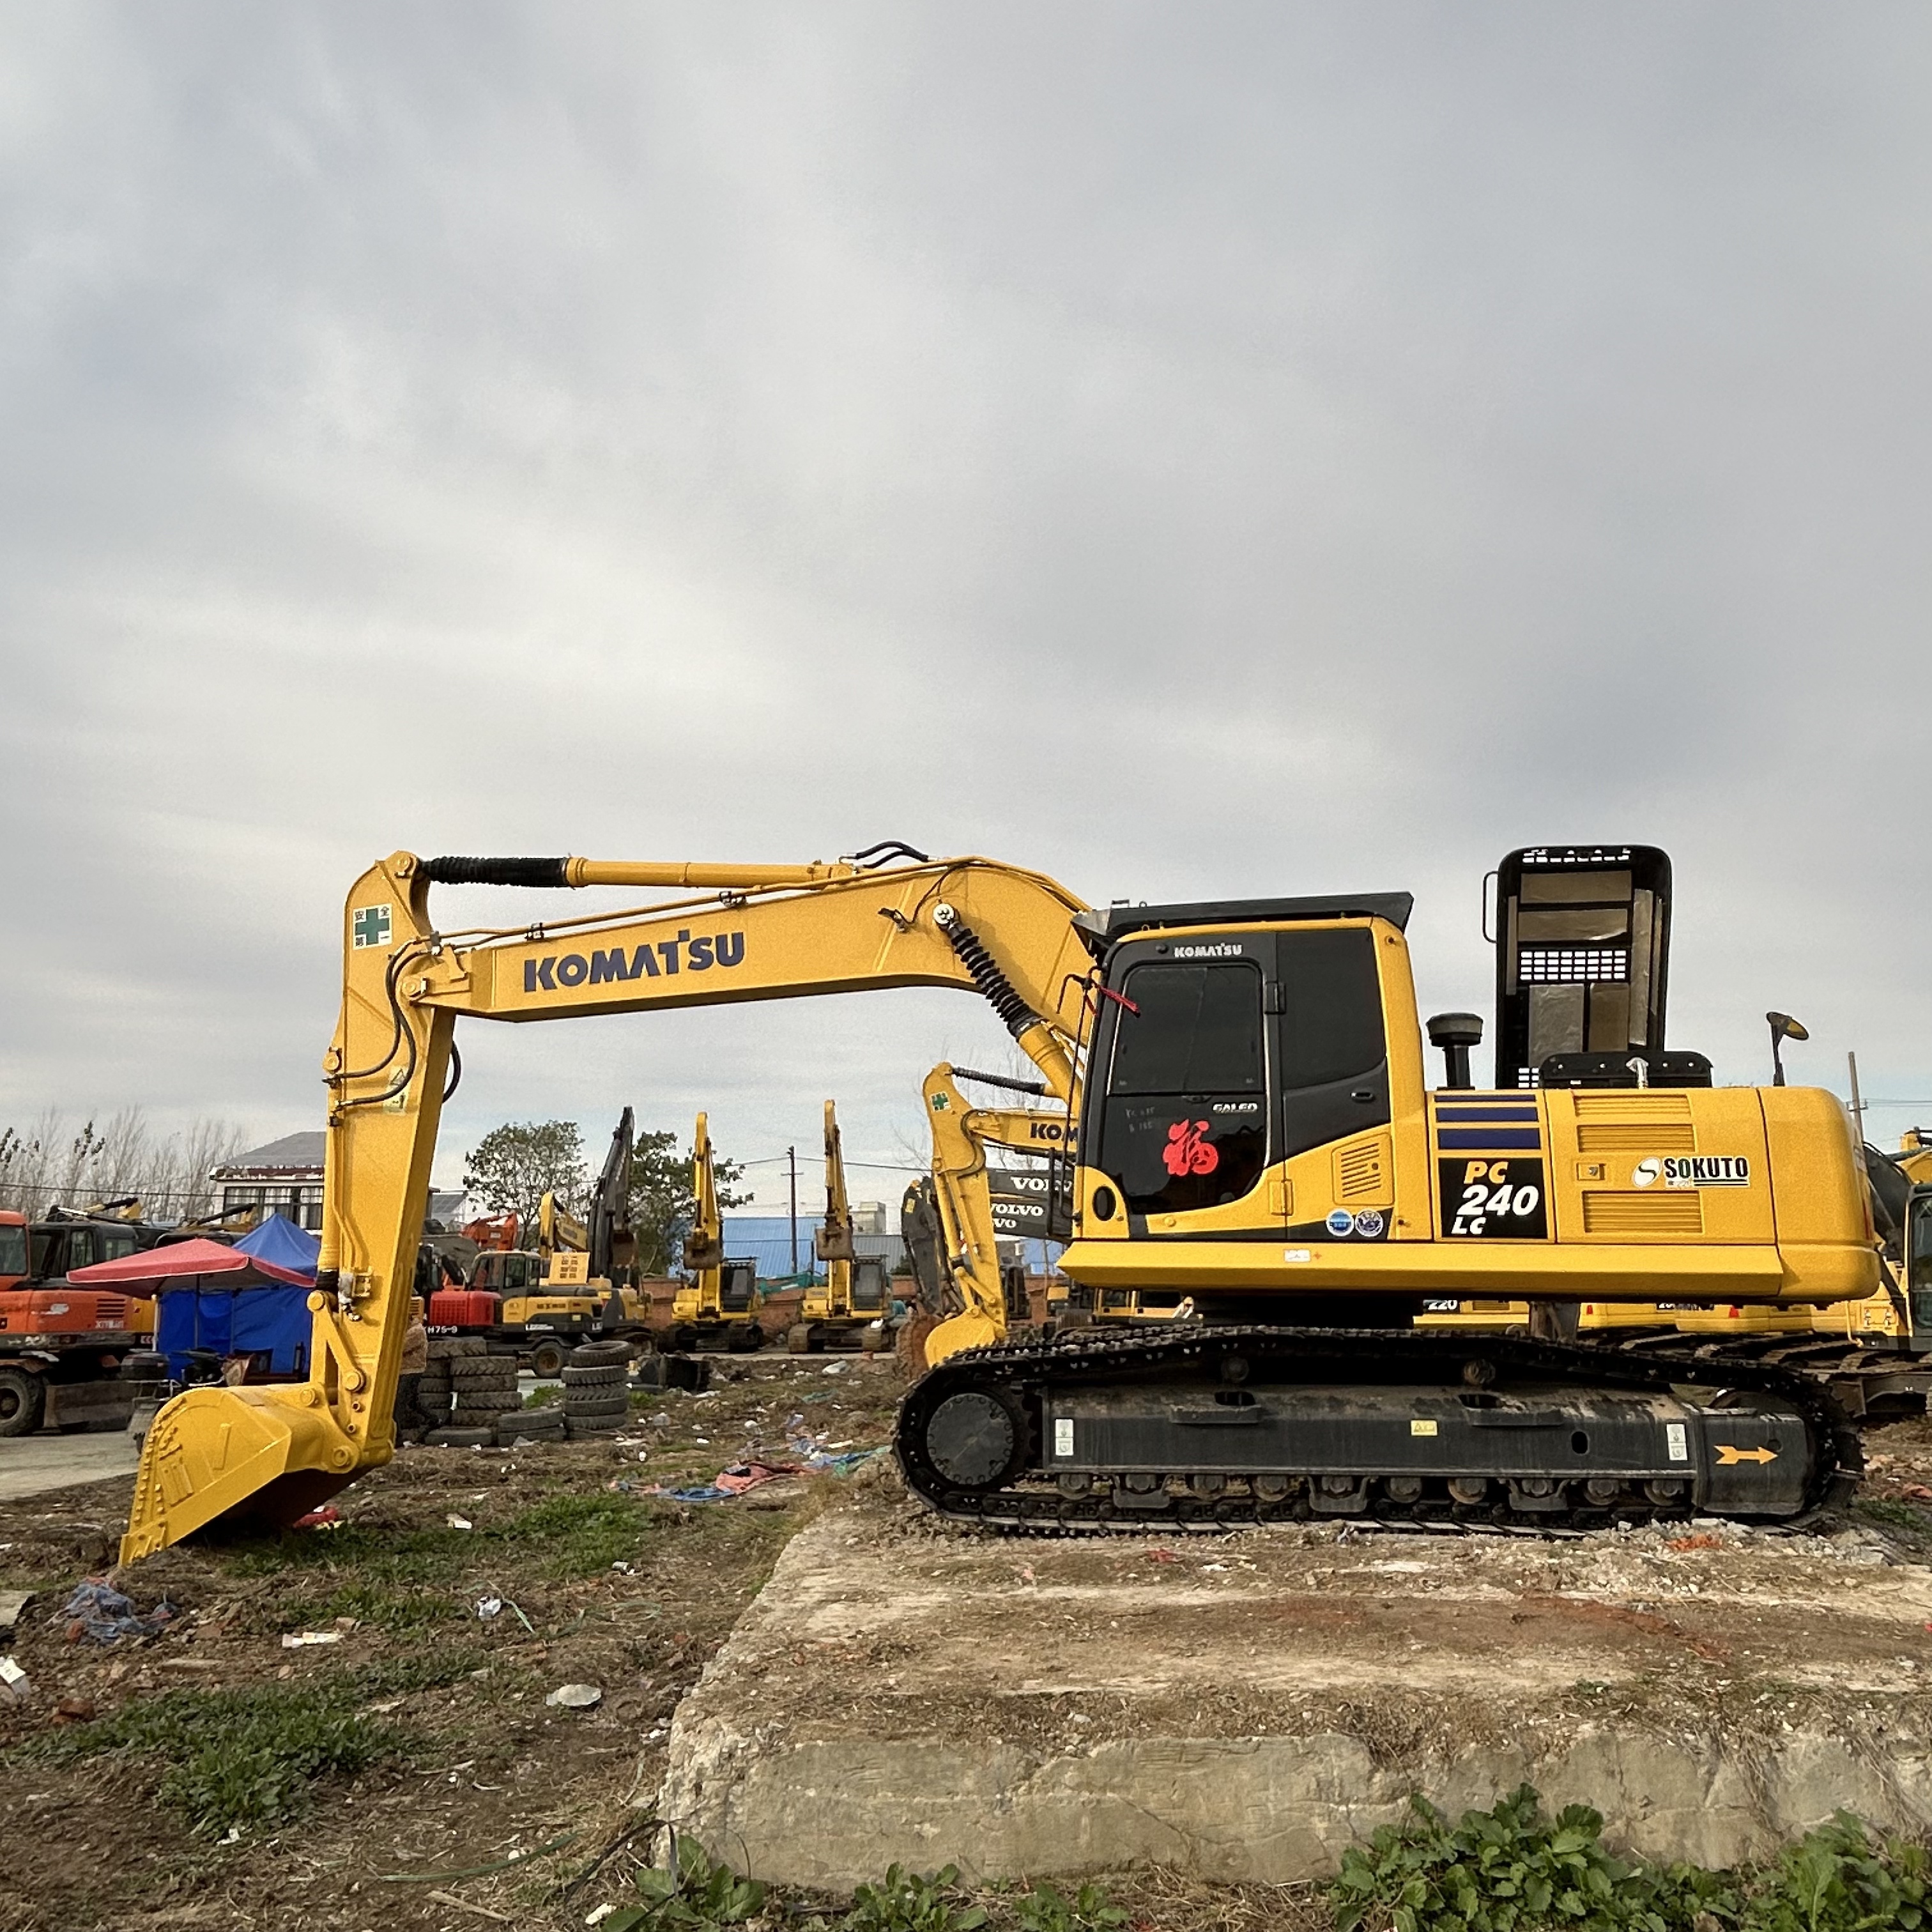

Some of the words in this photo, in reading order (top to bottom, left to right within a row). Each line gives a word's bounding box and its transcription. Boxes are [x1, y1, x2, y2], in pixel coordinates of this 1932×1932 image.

[1174, 942, 1242, 958] KOMATSU
[524, 929, 745, 993] KOMATSU
[1030, 1123, 1078, 1142] KOM
[1463, 1161, 1508, 1184] PC
[1664, 1157, 1749, 1178] SOKUTO
[1456, 1184, 1538, 1216] 240
[1451, 1216, 1487, 1234] LC
